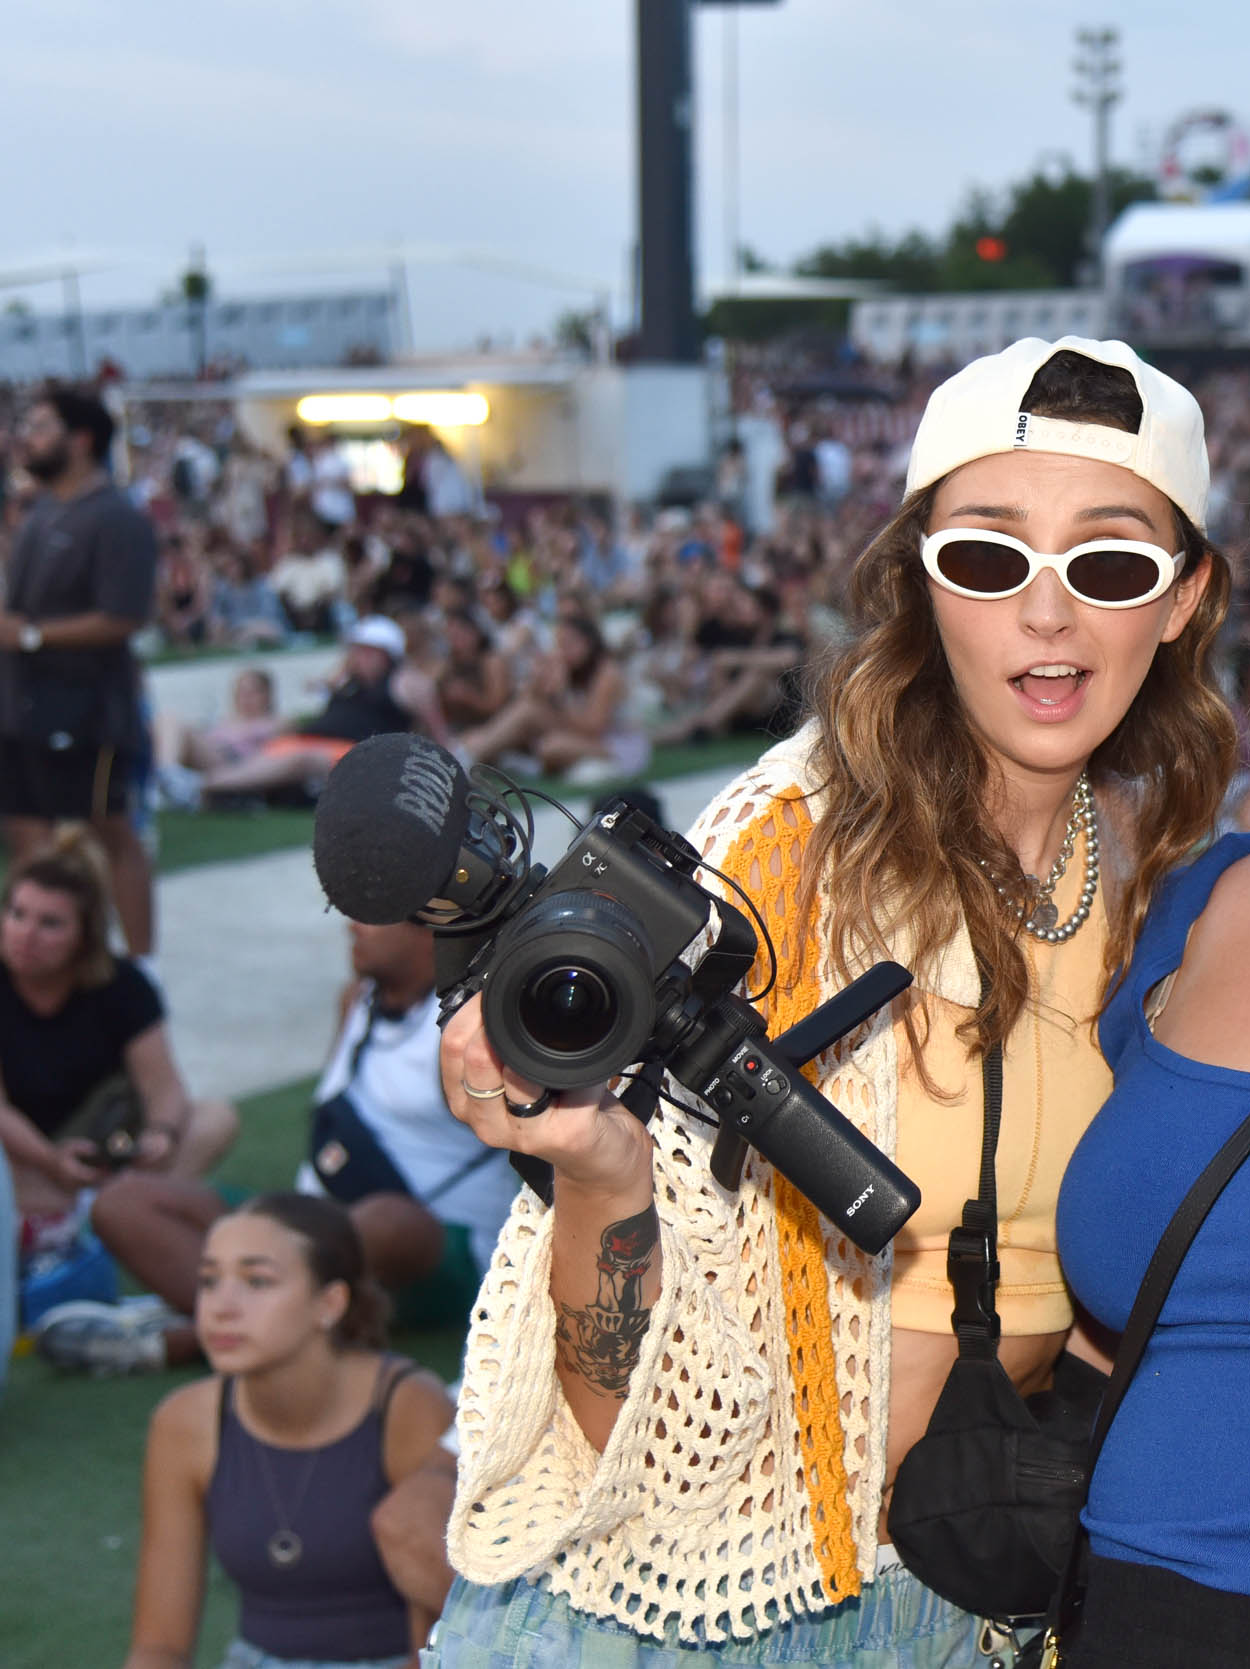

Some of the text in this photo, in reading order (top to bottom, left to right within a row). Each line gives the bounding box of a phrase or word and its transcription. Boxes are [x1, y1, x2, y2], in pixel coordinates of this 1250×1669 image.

[1015, 415, 1028, 442] OBEY
[731, 1046, 749, 1064] MOVIE
[760, 1068, 773, 1081] LOCK
[703, 1077, 720, 1096] PHOTO
[846, 1183, 875, 1217] SONY
